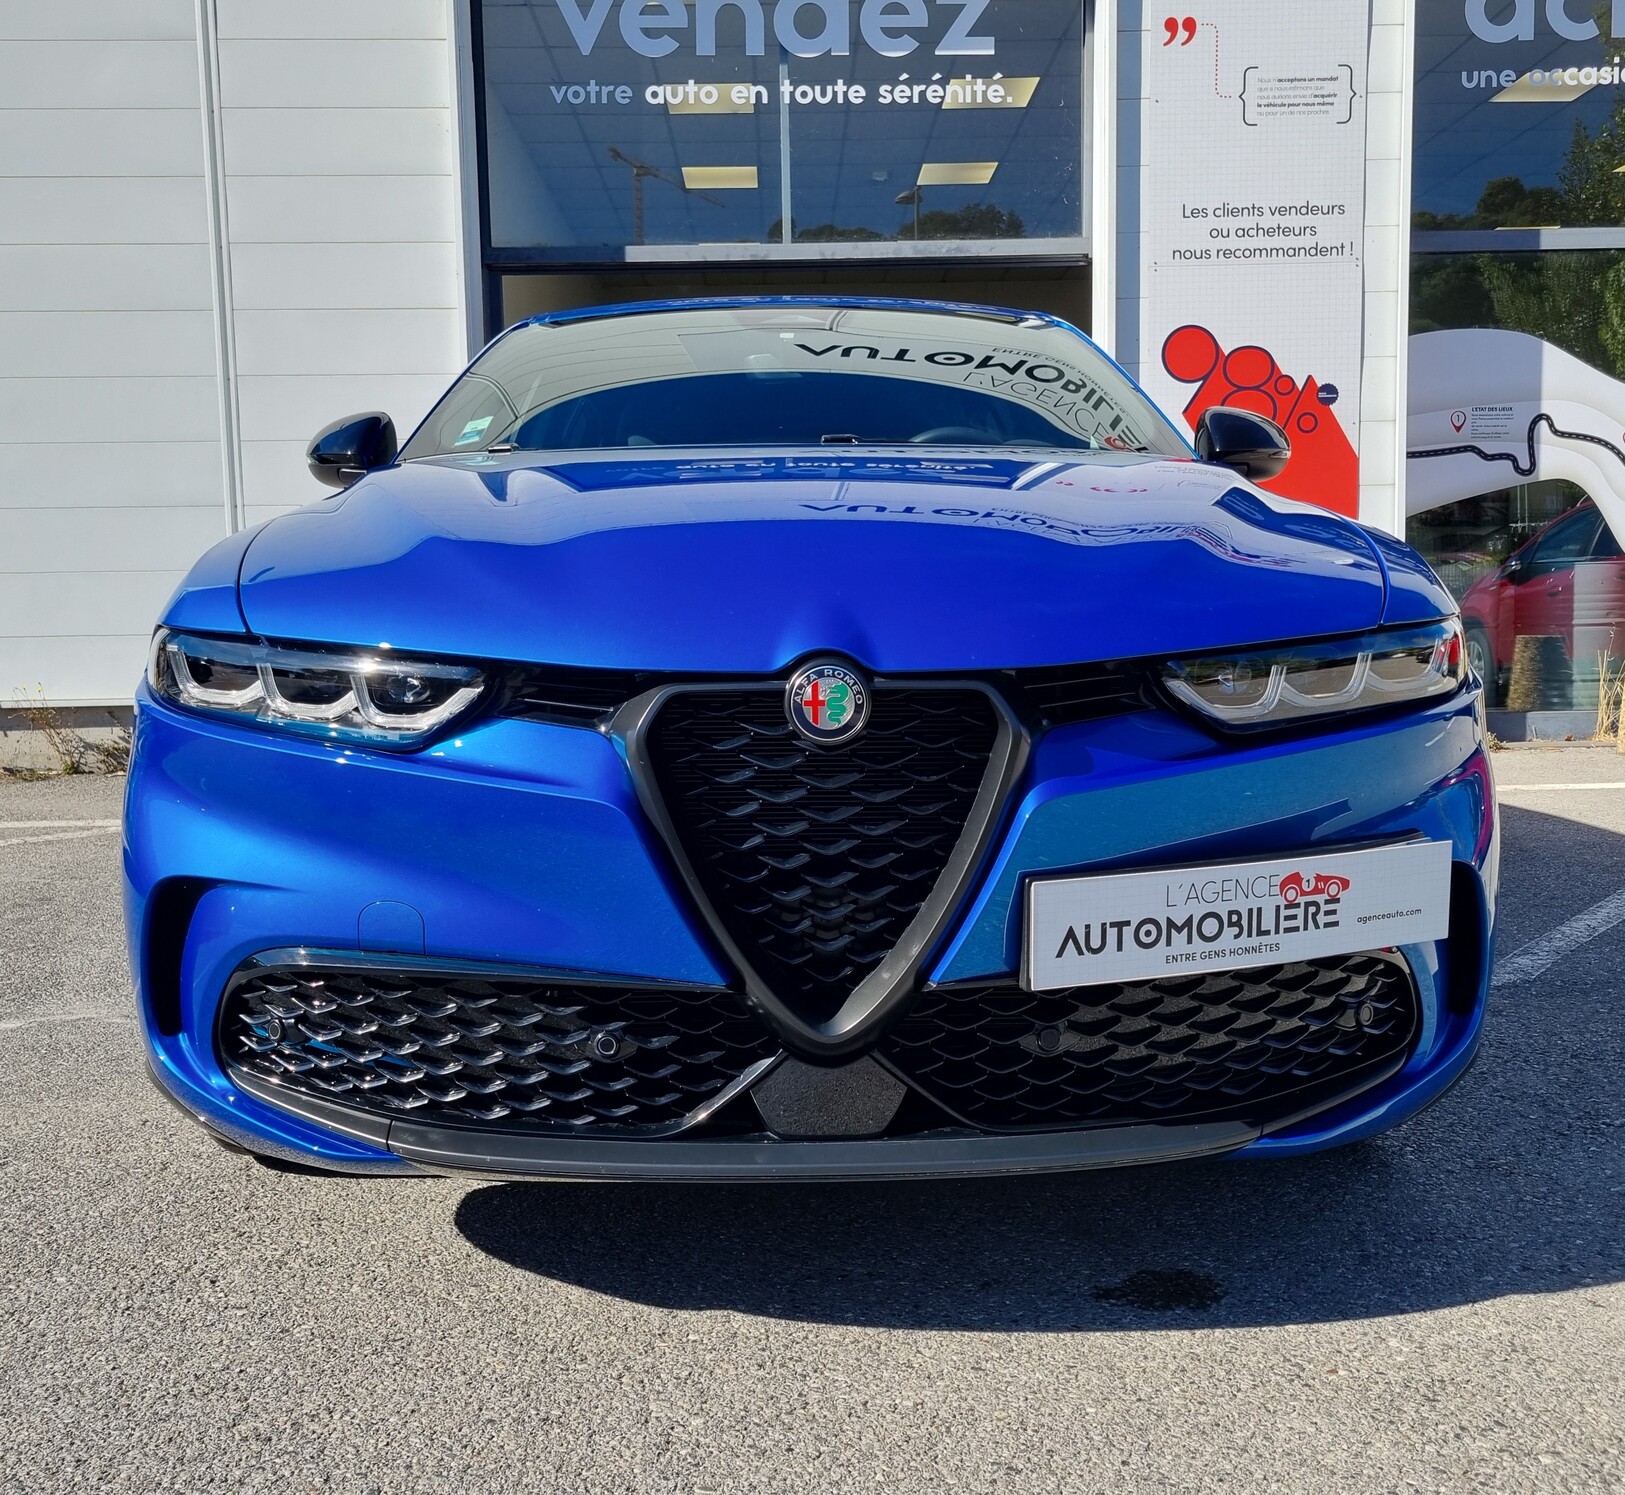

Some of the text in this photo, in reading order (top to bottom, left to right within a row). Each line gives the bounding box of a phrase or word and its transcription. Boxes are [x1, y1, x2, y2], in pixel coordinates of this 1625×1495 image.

[1461, 57, 1625, 88] une occasi
[550, 72, 1013, 104] votre auto en toute sérénité.
[1182, 201, 1345, 218] Les clients vendeurs
[1209, 222, 1317, 239] ou acheteurs
[1172, 246, 1211, 260] nous
[1216, 242, 1345, 259] recommandent
[794, 668, 864, 705] ALFA ROMEO
[1166, 874, 1280, 907] L'AGENCE
[1305, 878, 1311, 889] 1
[1356, 908, 1422, 925] agenceauto.com
[1165, 942, 1281, 964] ENTRE GENS HONNÊTES
